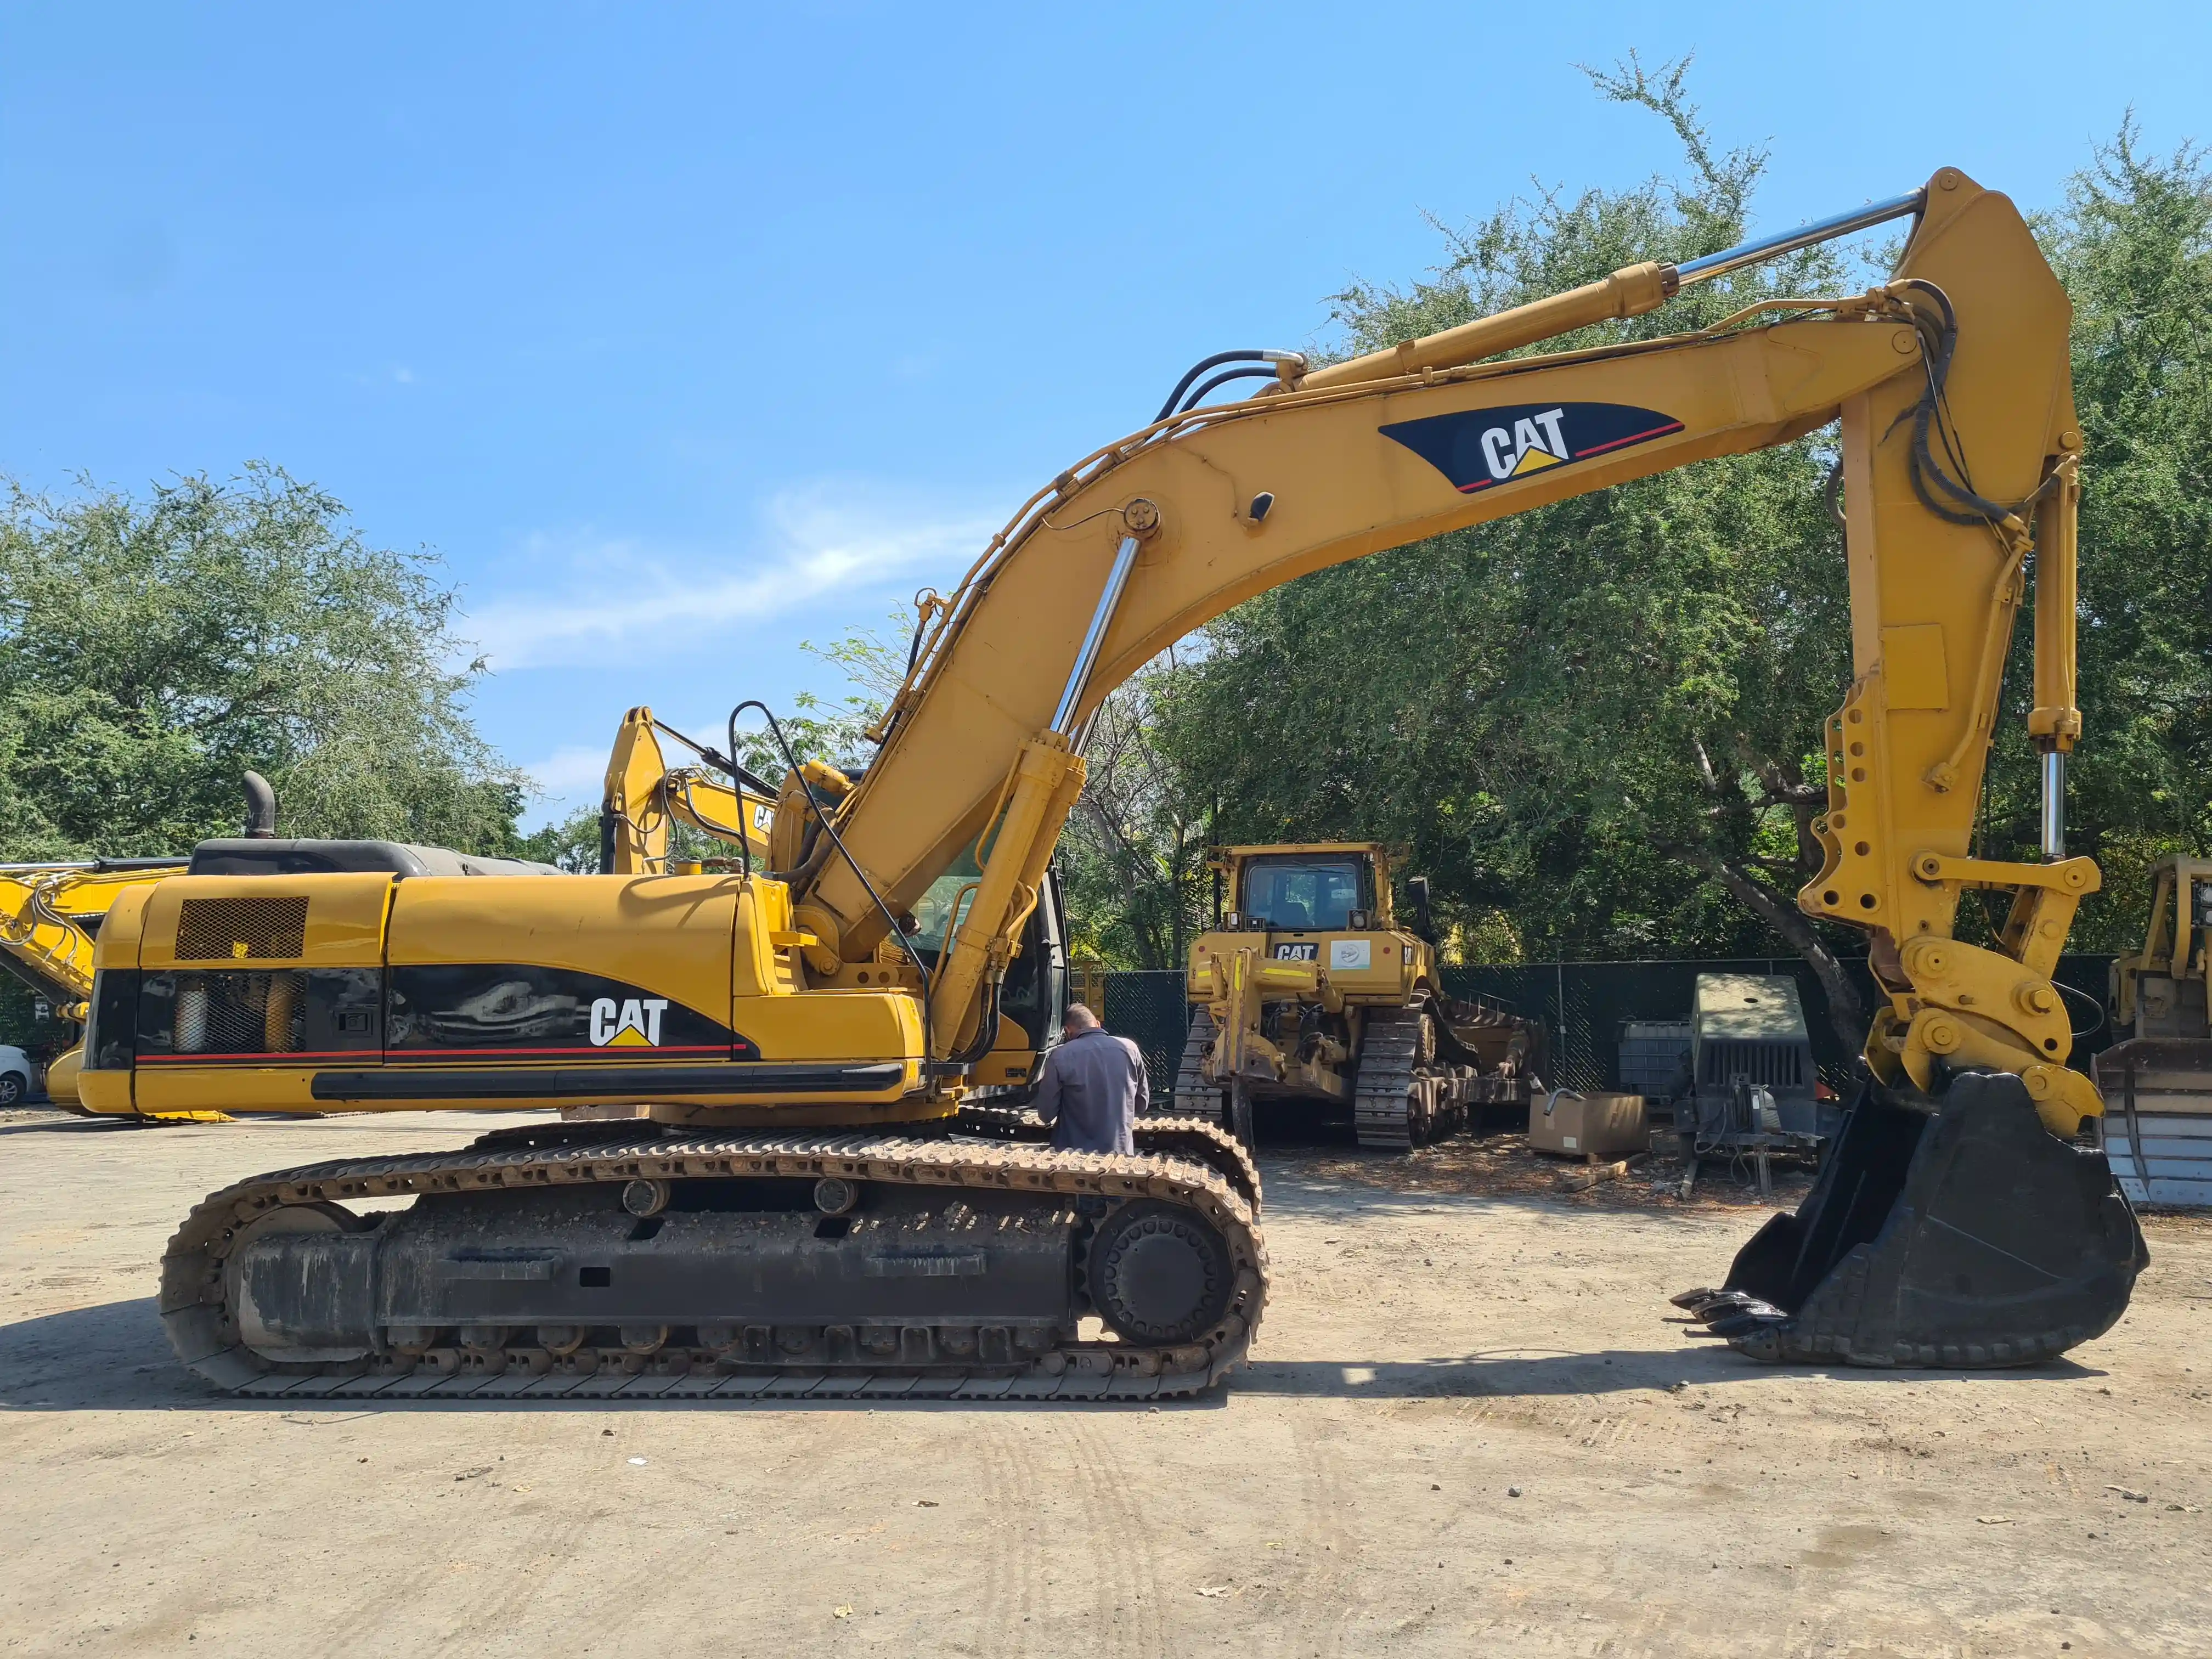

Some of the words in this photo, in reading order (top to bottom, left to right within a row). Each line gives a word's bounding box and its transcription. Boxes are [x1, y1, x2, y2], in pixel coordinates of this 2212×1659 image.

[1481, 408, 1568, 478] CAT
[754, 805, 775, 828] CA
[1278, 945, 1314, 960] CAT
[590, 998, 668, 1046] CAT
